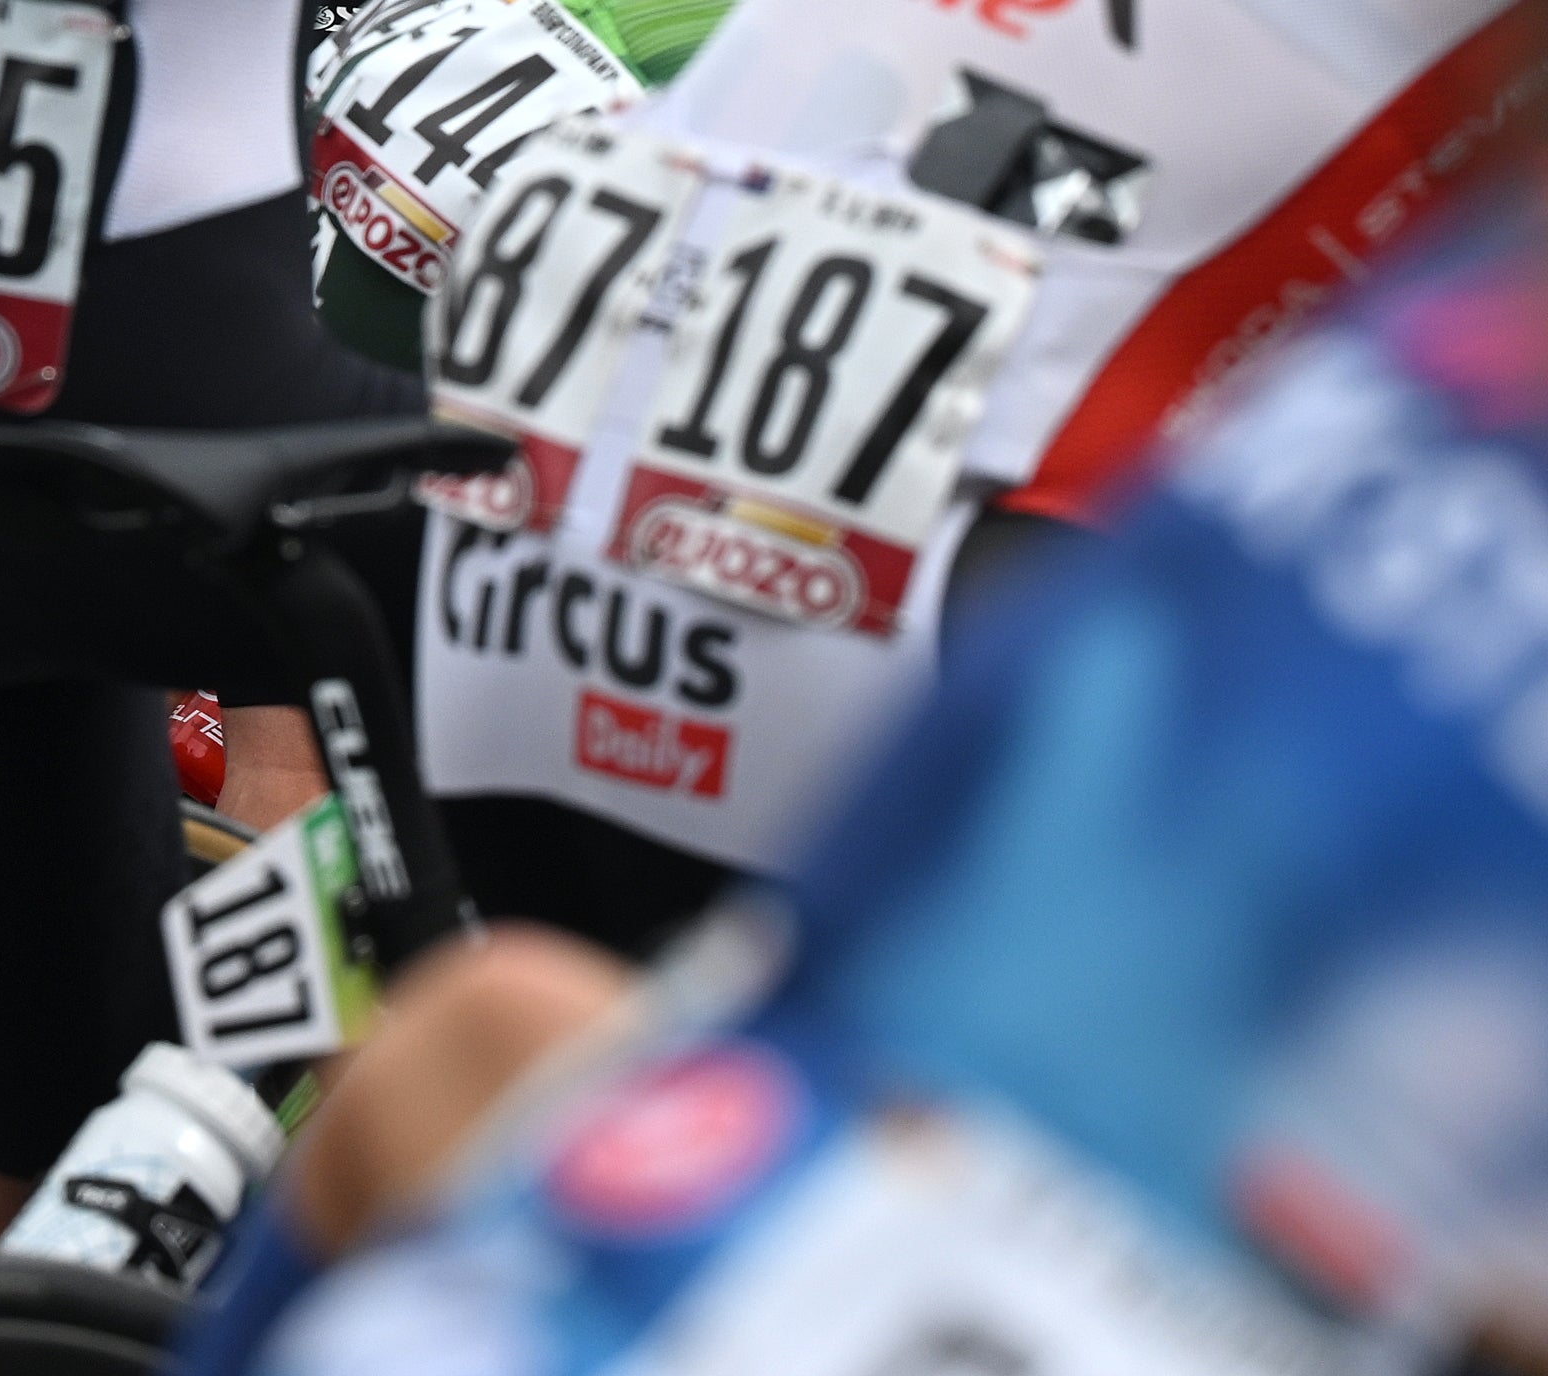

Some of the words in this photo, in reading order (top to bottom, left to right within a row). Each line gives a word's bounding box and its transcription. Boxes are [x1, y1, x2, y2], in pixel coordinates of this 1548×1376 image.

[440, 174, 664, 410] 87
[657, 232, 991, 509] 187
[439, 510, 743, 708] Circus
[310, 676, 413, 901] CUBE
[187, 862, 313, 1040] 187
